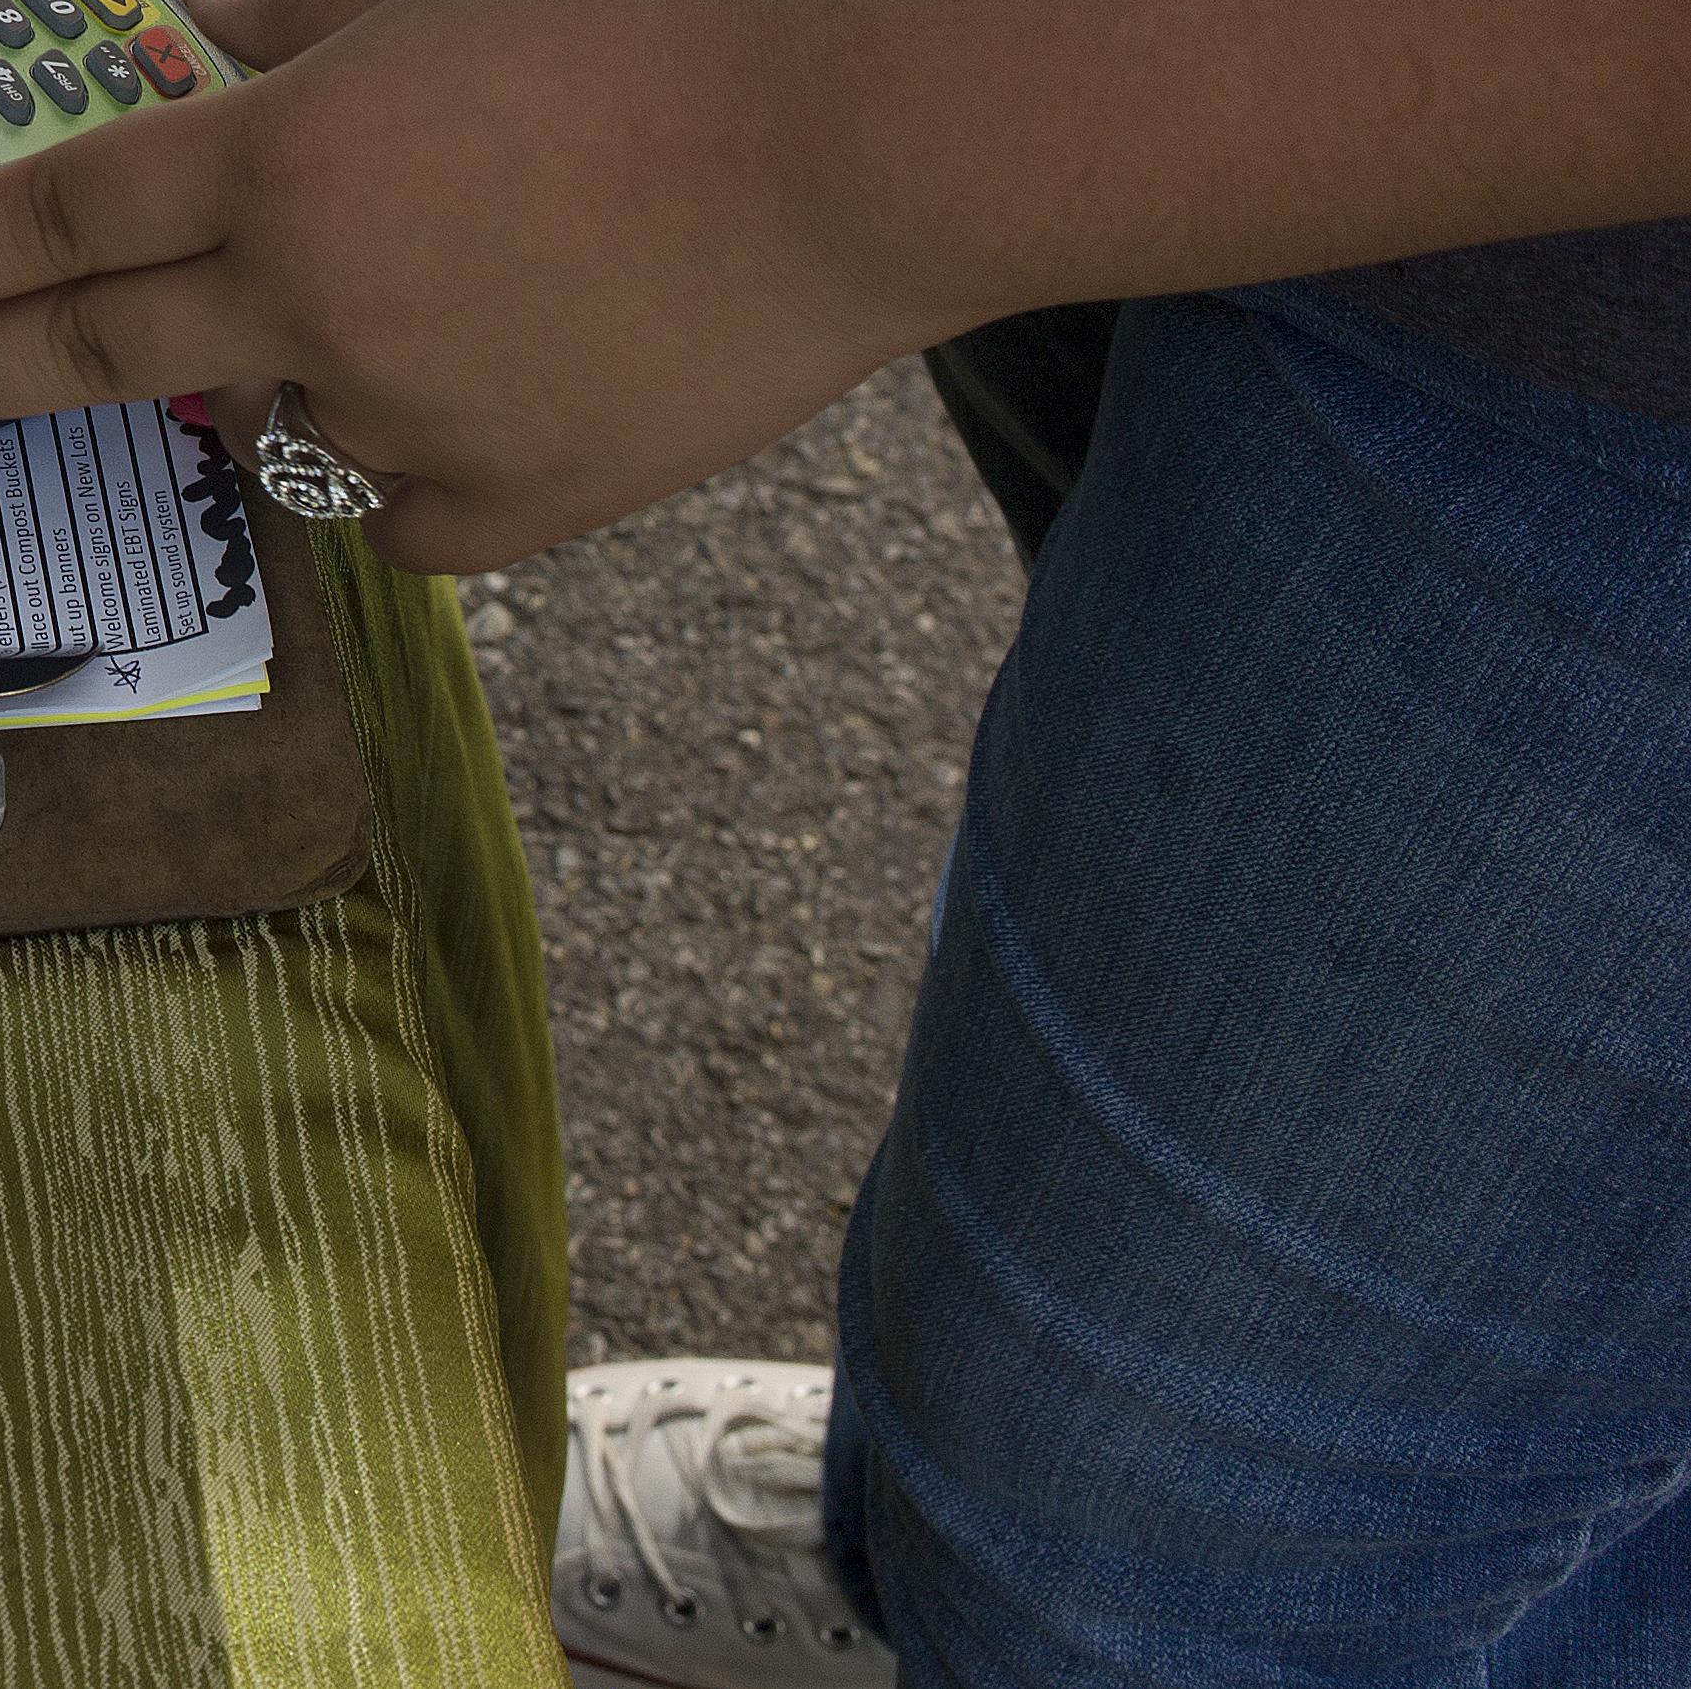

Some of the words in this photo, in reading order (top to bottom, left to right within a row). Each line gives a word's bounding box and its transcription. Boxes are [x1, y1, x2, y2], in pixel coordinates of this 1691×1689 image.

[0, 81, 25, 102] GHI
[52, 72, 79, 93] PRS
[68, 425, 88, 459] Lots
[0, 437, 25, 499] Buckets
[76, 459, 97, 499] New
[83, 501, 102, 524] on
[116, 479, 139, 522] Signs
[153, 488, 179, 542] system
[8, 500, 36, 576] Compost
[87, 526, 112, 568] signs
[120, 525, 144, 556] EBT
[51, 526, 76, 596] banners
[160, 545, 185, 587] sound
[22, 578, 44, 609] out
[65, 597, 86, 621] up
[99, 571, 125, 651] Welcome
[126, 558, 162, 645] Laminated
[174, 587, 193, 610] up
[178, 610, 196, 636] Set
